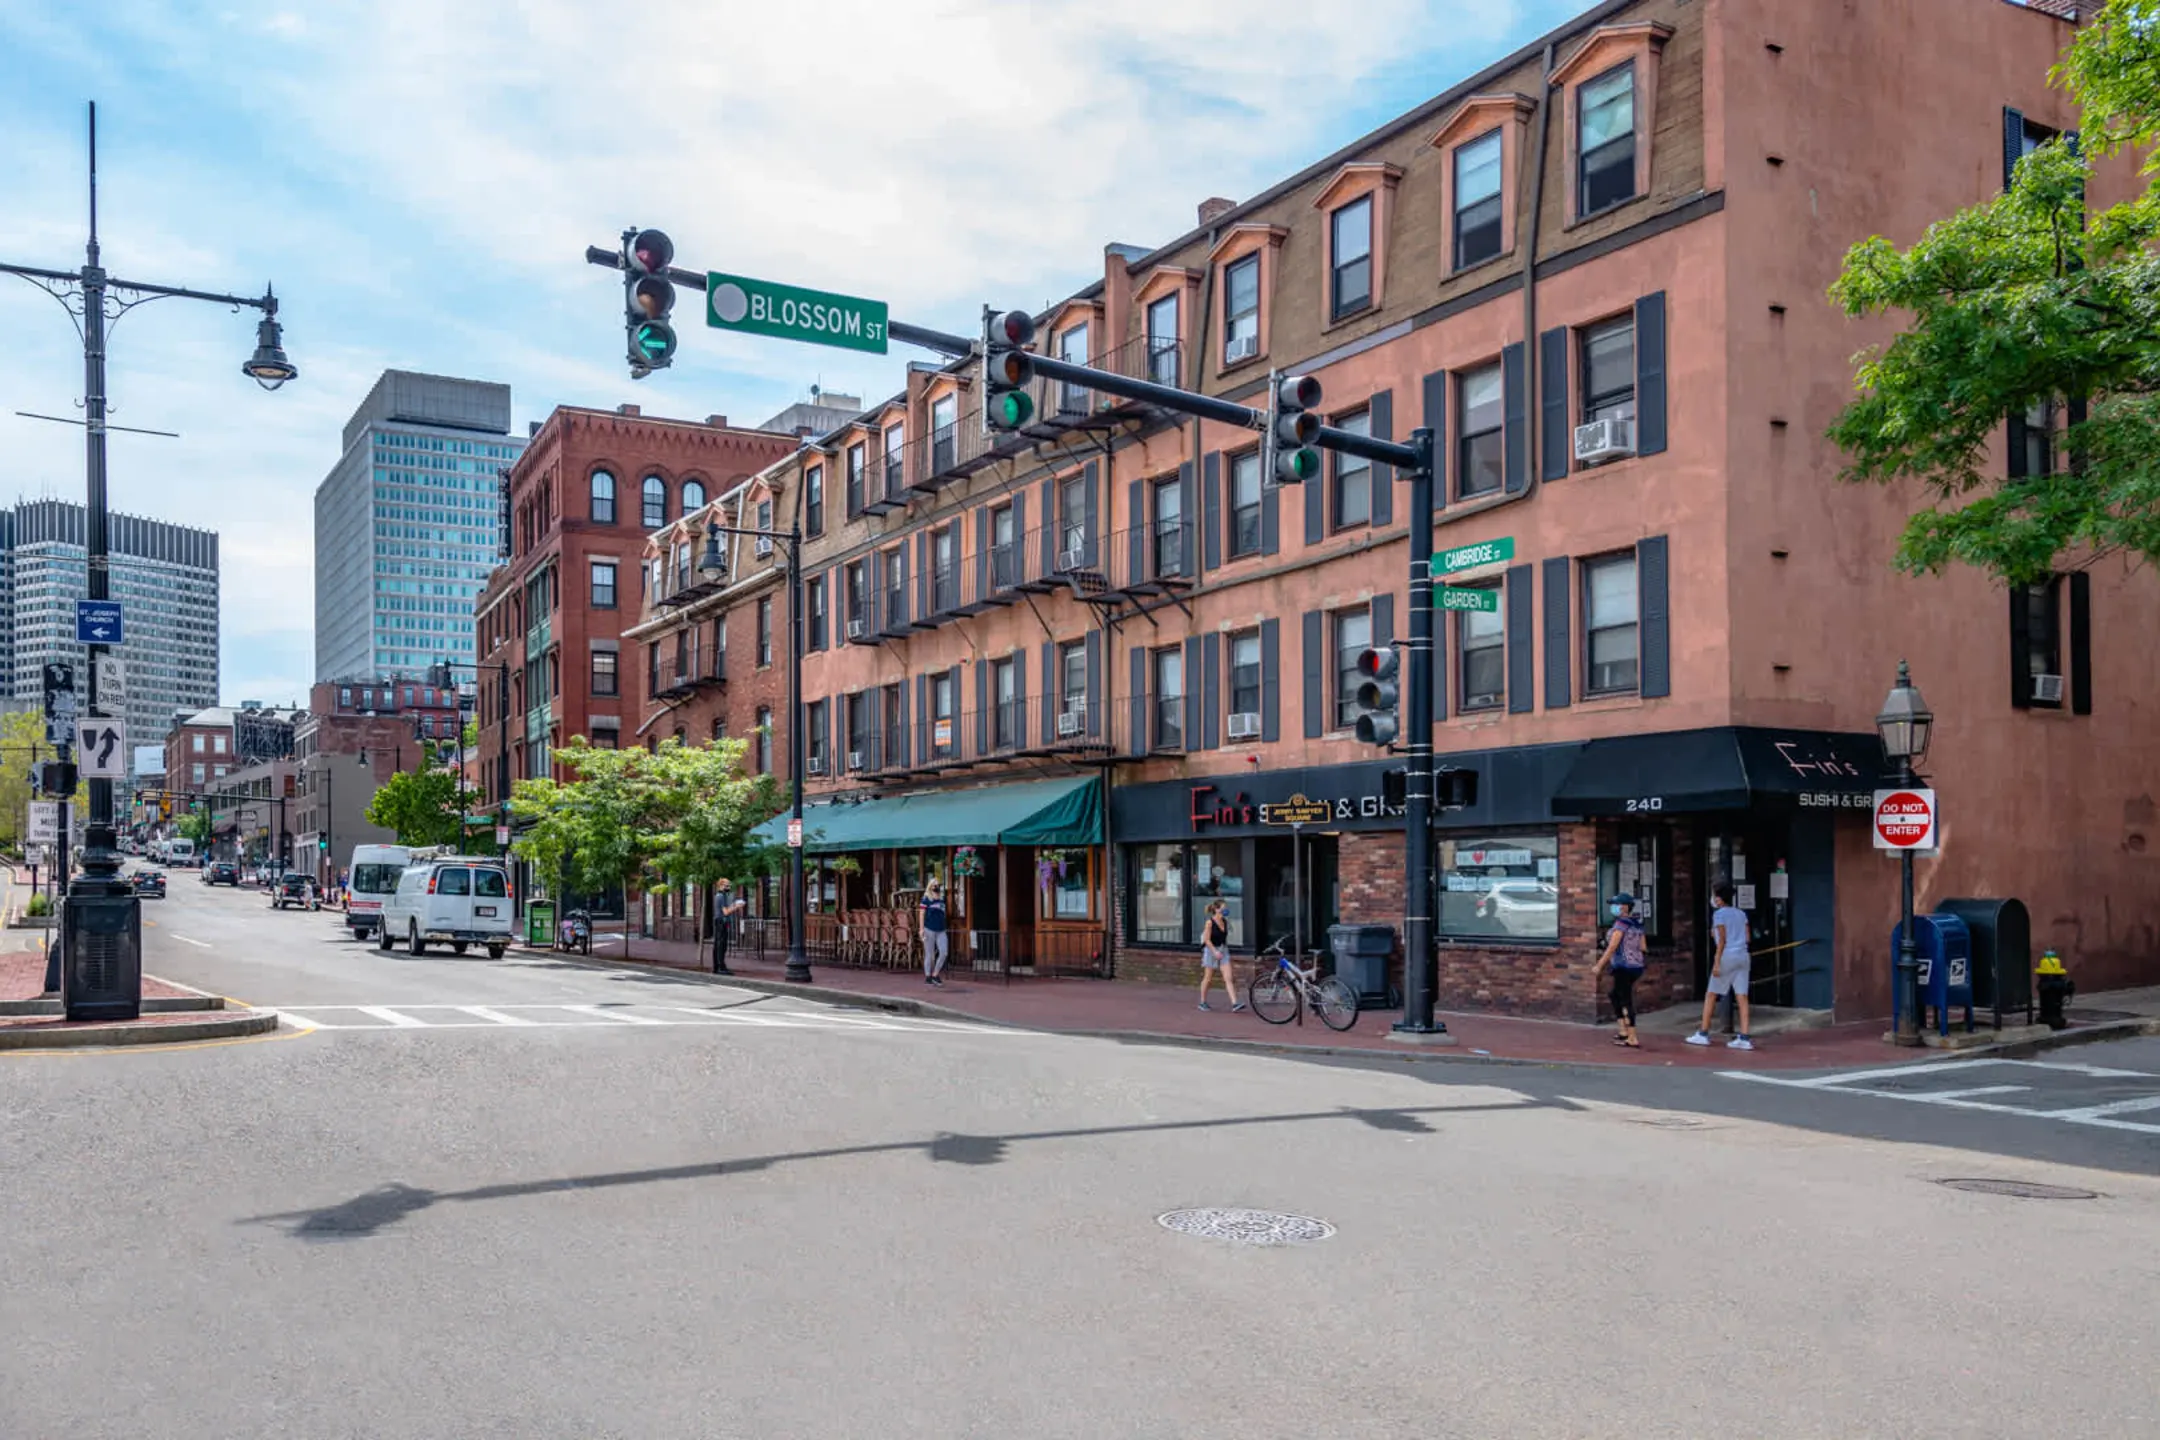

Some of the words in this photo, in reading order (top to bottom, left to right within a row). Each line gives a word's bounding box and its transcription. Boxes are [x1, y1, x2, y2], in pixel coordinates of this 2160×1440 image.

[751, 294, 861, 337] BLOSSOM
[866, 323, 882, 340] ST
[1445, 544, 1493, 569] CAMBRIDGE
[1443, 591, 1482, 608] GARDEN
[104, 662, 117, 675] NO
[102, 677, 122, 690] TURN
[99, 691, 110, 703] ON
[110, 694, 125, 706] RED
[1775, 742, 1859, 777] Fin's
[1626, 798, 1662, 811] 240
[1799, 792, 1839, 807] SUSHI
[1841, 795, 1852, 807] &
[1191, 786, 1252, 832] Fin's
[1336, 798, 1353, 818] &
[1883, 803, 1898, 813] DO
[1902, 803, 1924, 813] NOT
[1886, 826, 1921, 836] ENTER
